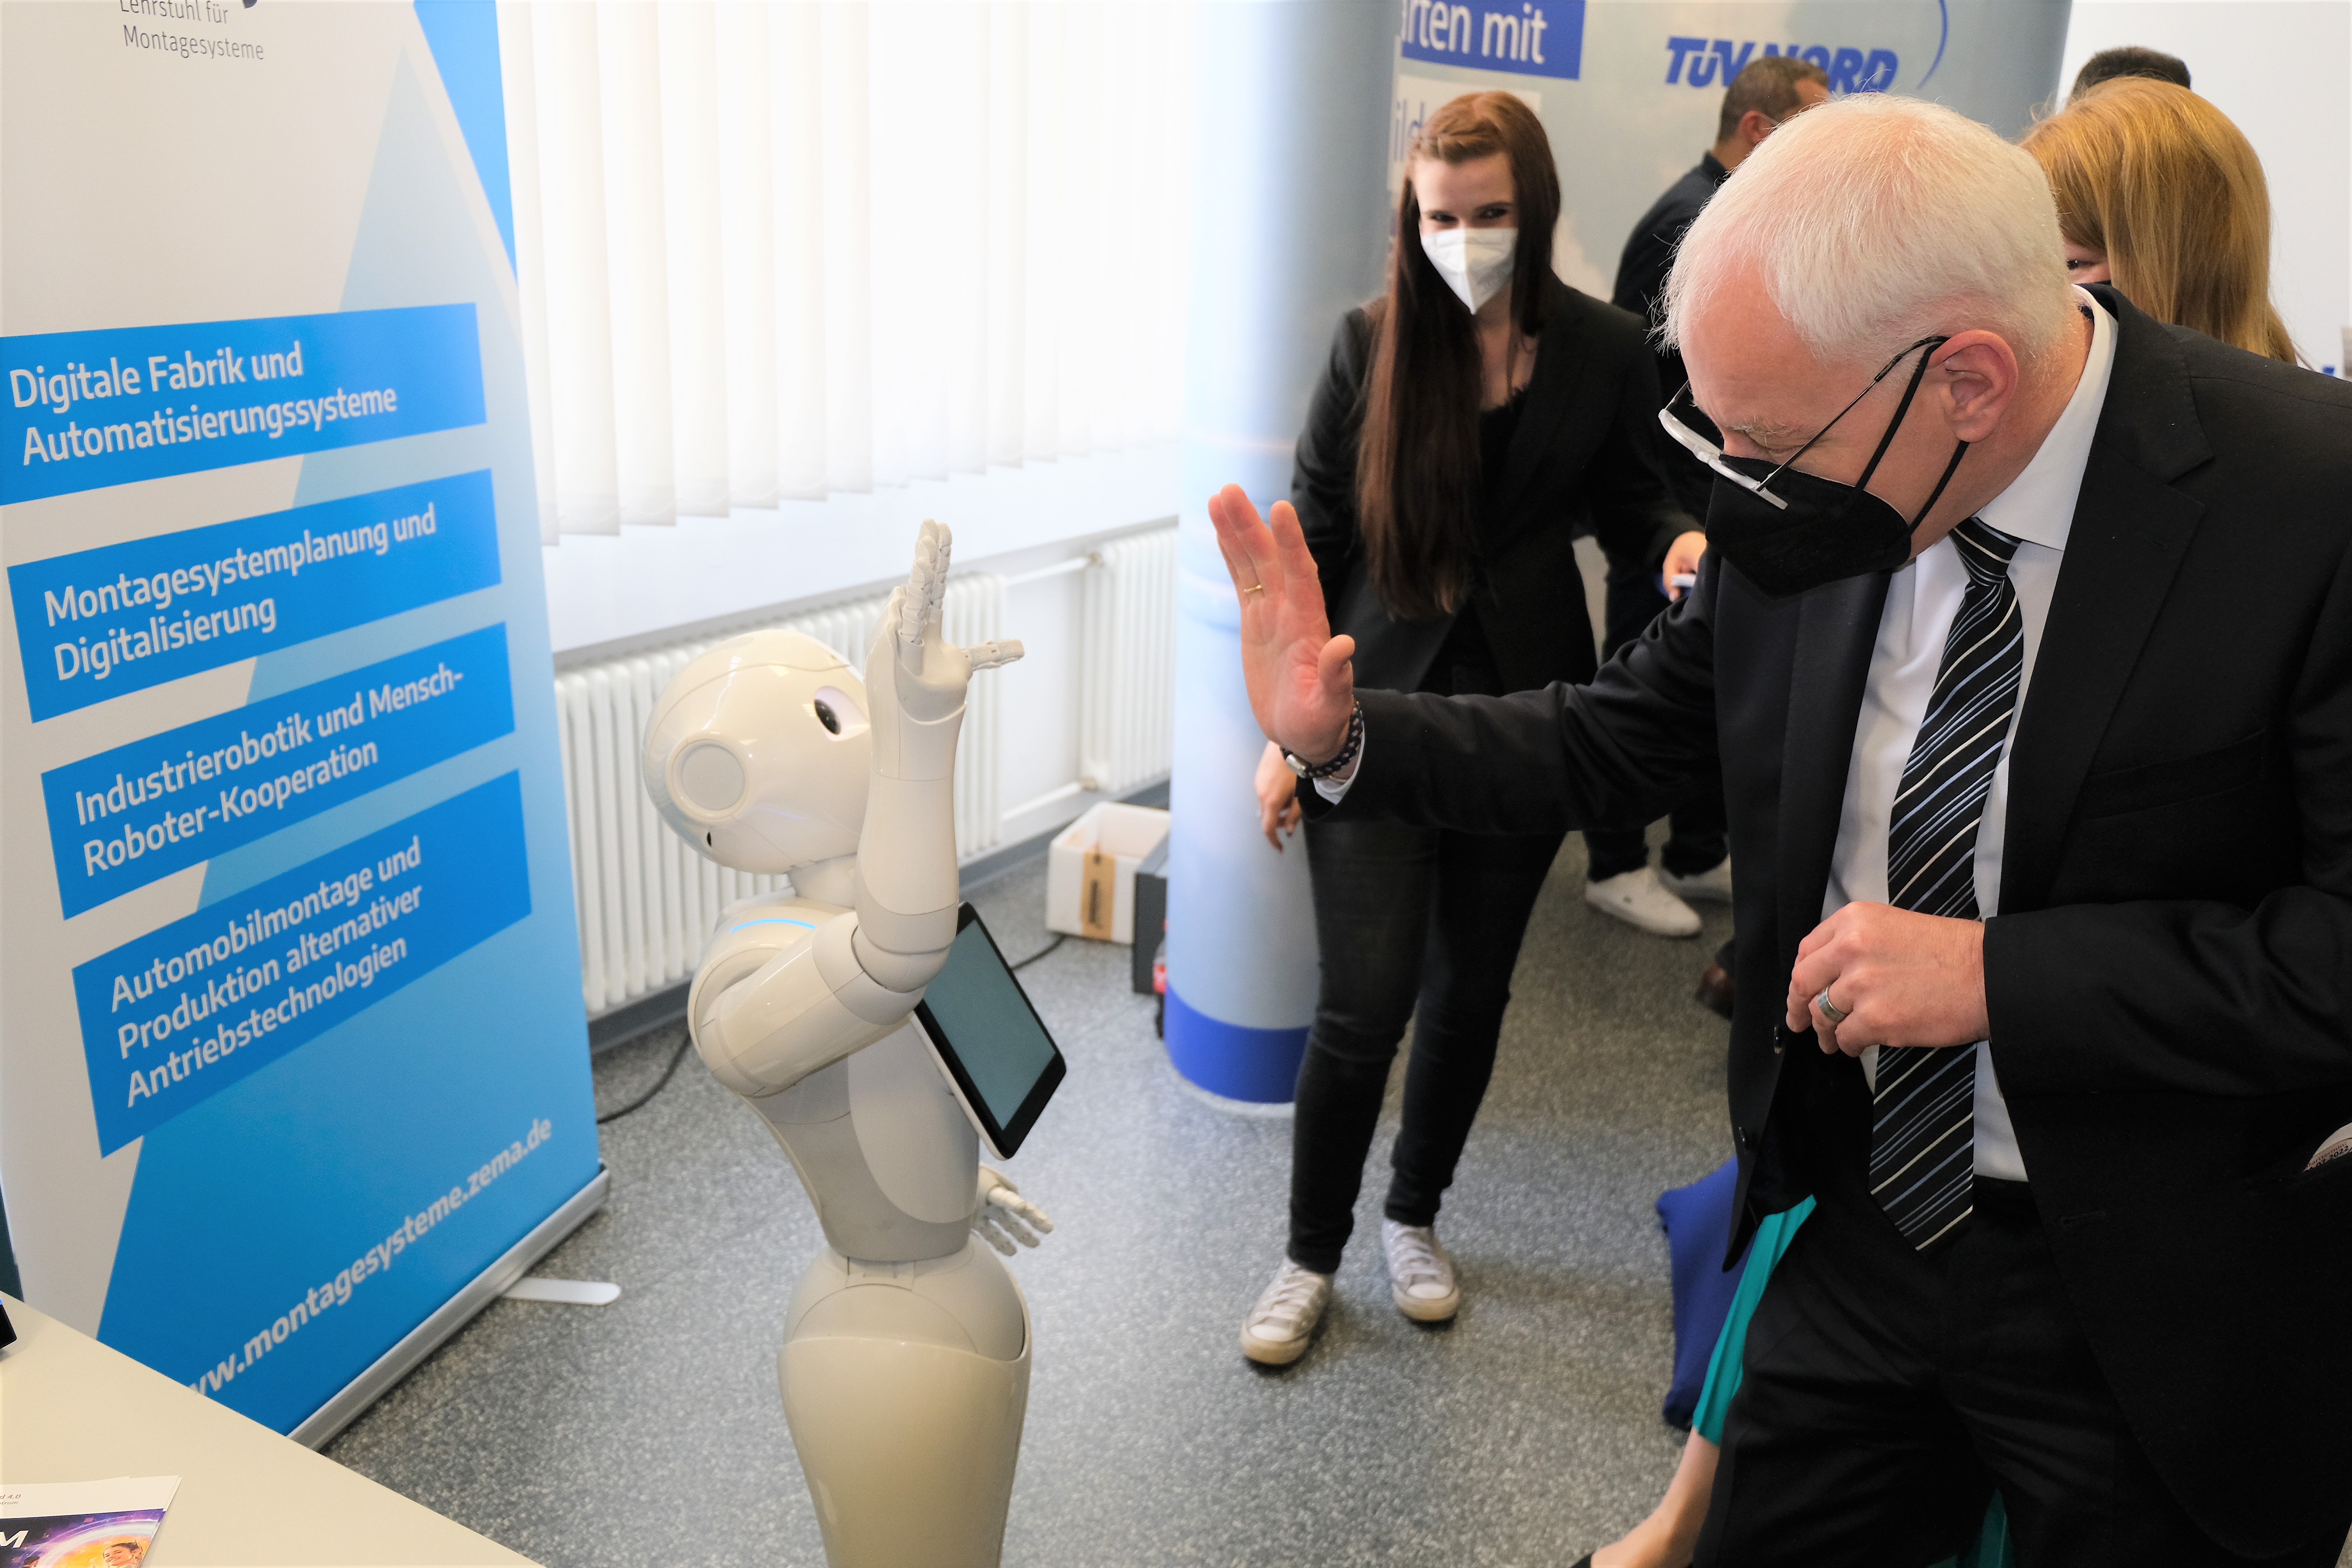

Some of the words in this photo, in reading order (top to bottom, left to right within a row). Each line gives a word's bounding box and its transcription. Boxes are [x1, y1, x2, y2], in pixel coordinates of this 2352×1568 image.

[123, 24, 263, 60] Montagesysteme
[206, 1, 228, 24] für
[1481, 2, 1547, 64] mit
[10, 358, 141, 414] Digitale
[149, 347, 245, 392] Fabrik
[252, 341, 303, 381] und
[23, 386, 397, 465] Automatisierungssysteme
[44, 531, 388, 626] Montagesystemplanung
[394, 502, 436, 542] und
[54, 597, 276, 680] Digitalisierung
[76, 713, 313, 825] Industrierobotik
[317, 692, 363, 738] und
[369, 662, 463, 719] Mensch-
[84, 742, 378, 877] Roboter-Kooperation
[112, 867, 373, 1012] Automobilmontage
[378, 835, 422, 882] und
[118, 958, 279, 1059] Produktion
[287, 885, 423, 973] alternativer
[128, 937, 407, 1107] Antriebstechnologien
